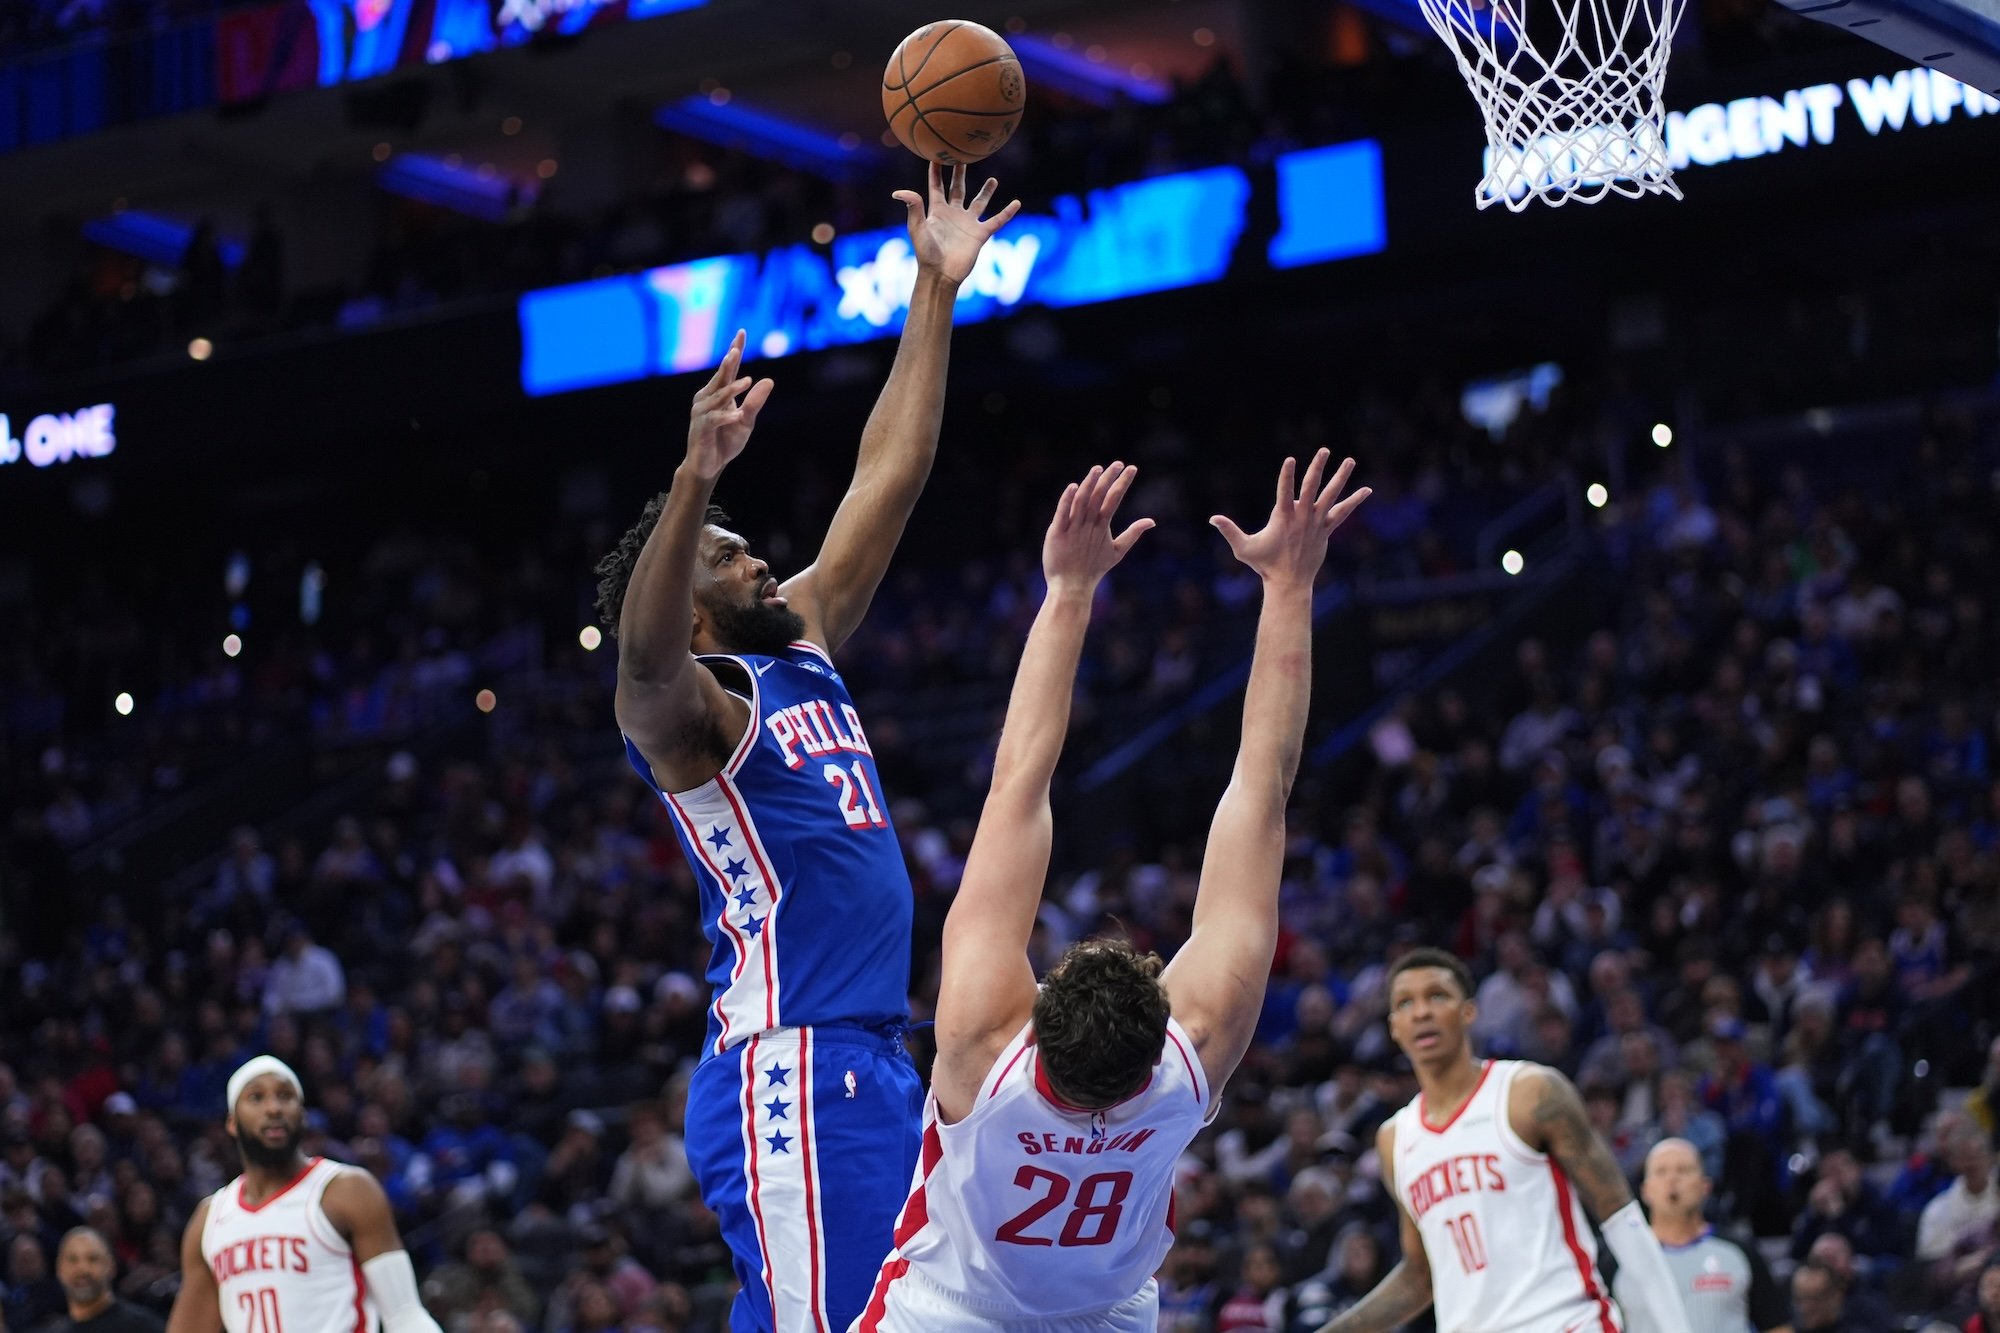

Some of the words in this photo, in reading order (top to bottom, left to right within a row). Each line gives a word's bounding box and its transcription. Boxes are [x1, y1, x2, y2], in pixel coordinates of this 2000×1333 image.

[823, 760, 888, 831] 21
[995, 1164, 1134, 1248] 28
[1408, 1154, 1506, 1219] ROCKETS
[213, 1235, 309, 1285] ROCKETS
[1445, 1212, 1488, 1276] 10
[238, 1287, 284, 1333] 20
